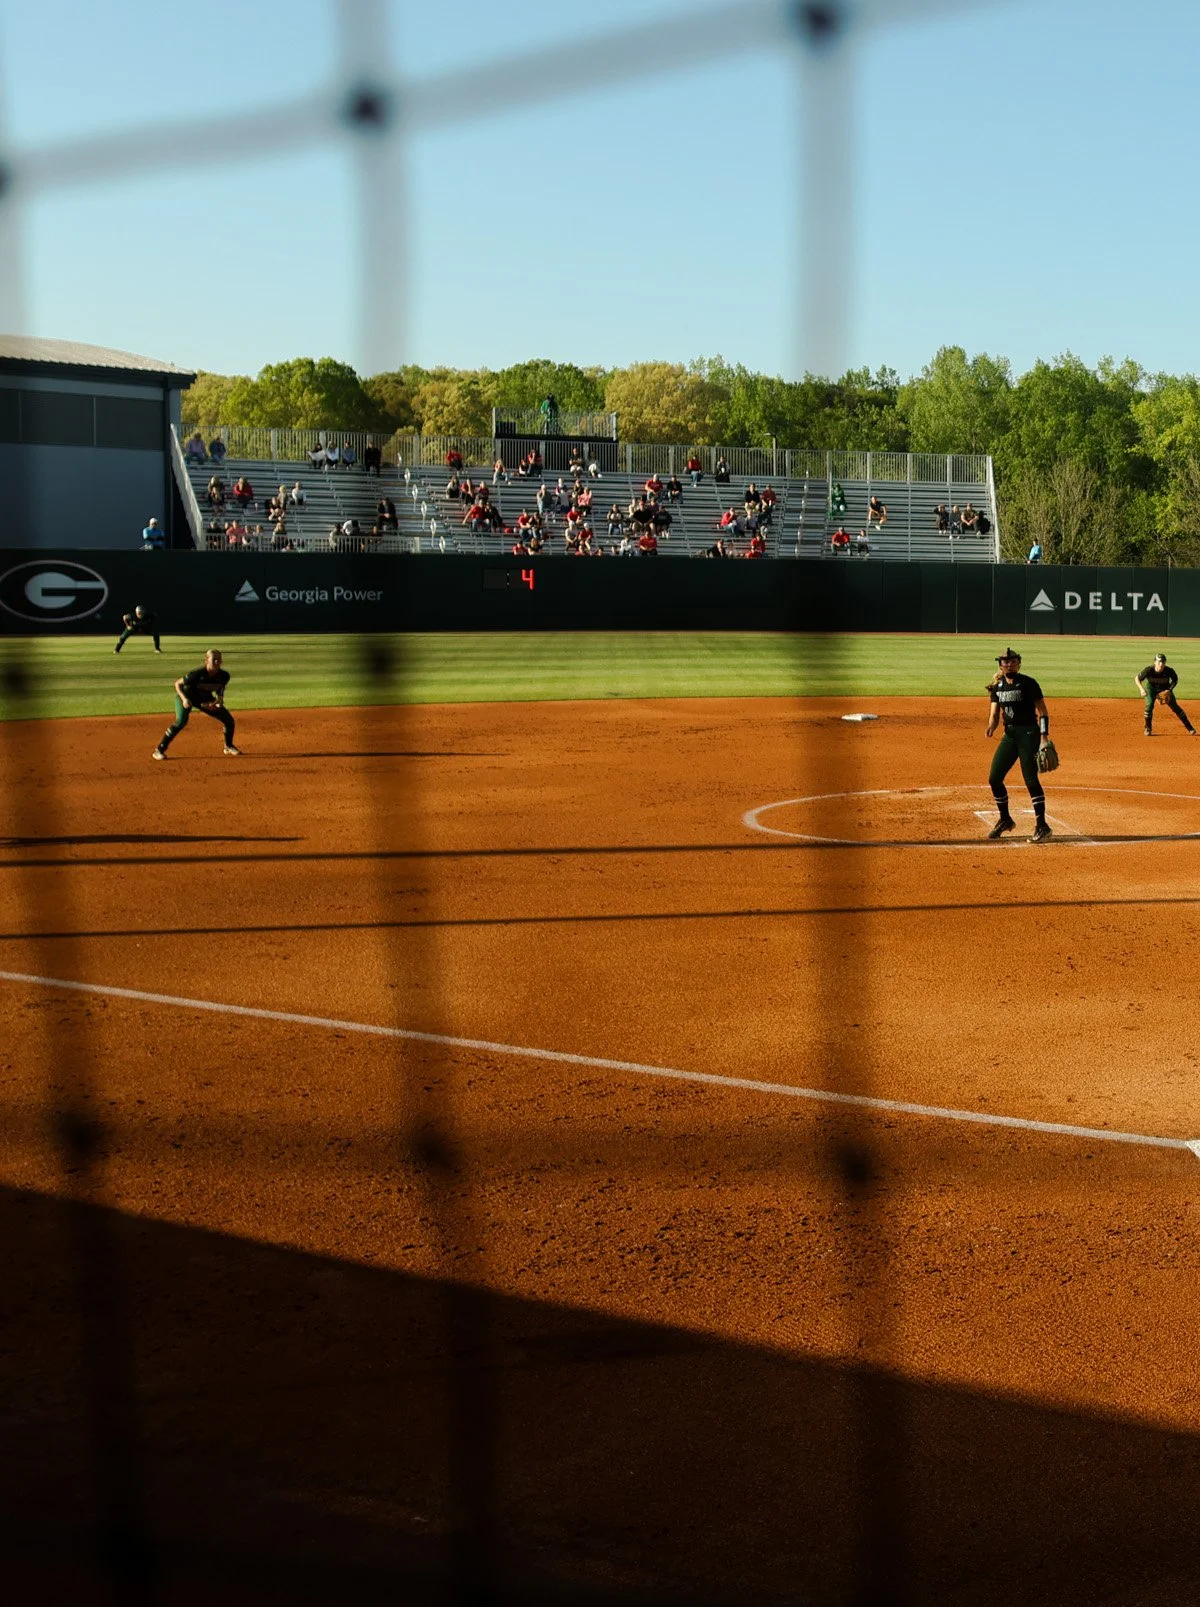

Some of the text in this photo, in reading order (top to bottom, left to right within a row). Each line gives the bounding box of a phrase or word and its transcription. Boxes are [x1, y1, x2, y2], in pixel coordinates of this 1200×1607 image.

[522, 568, 534, 590] 4
[266, 586, 384, 604] Georgia Power
[1064, 591, 1164, 611] DELTA
